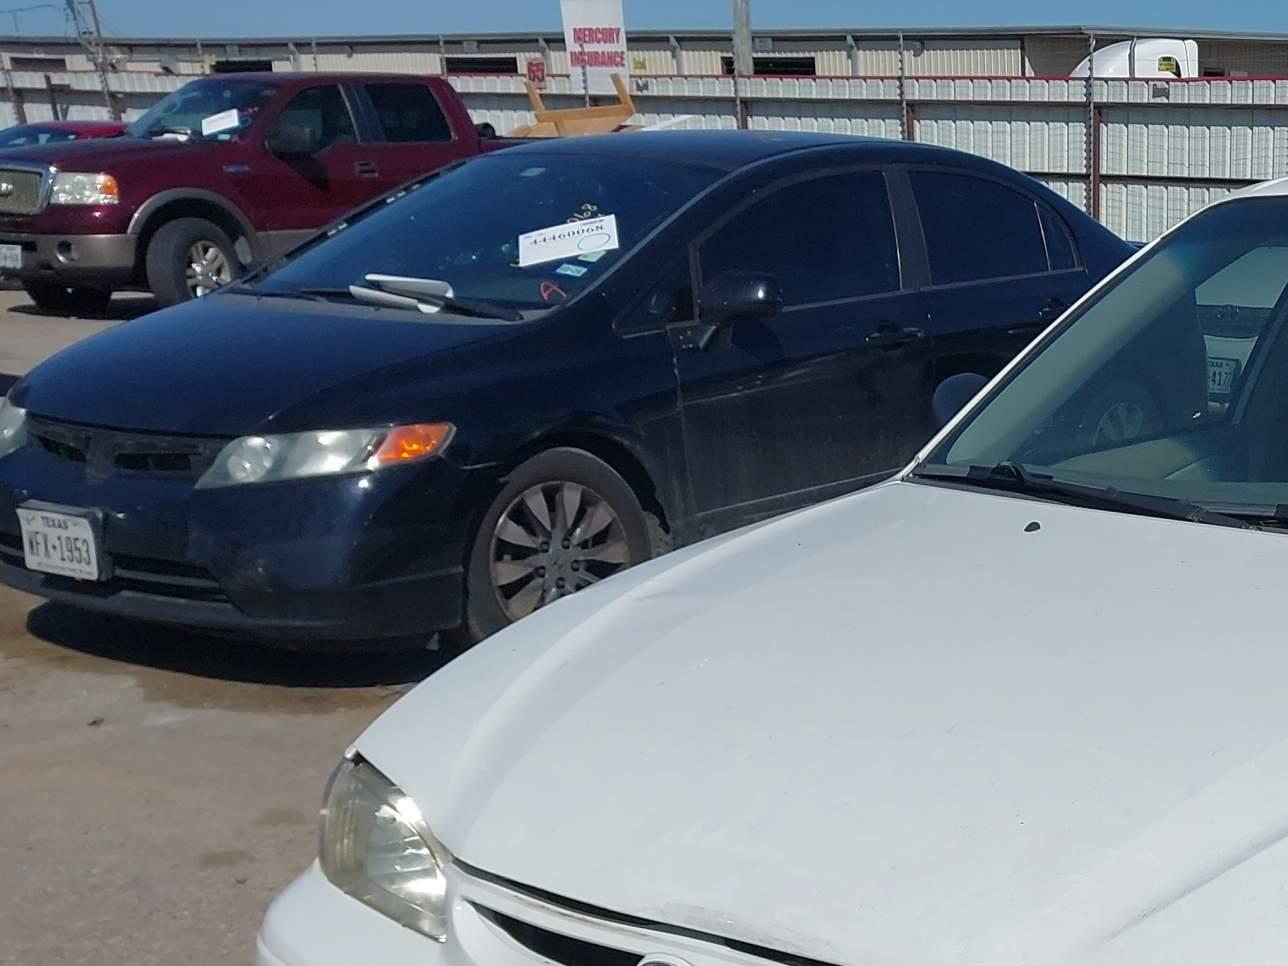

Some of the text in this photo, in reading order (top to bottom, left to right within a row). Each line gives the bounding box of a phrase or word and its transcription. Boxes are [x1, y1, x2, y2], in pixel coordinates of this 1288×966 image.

[573, 27, 621, 44] MERCURY
[570, 51, 625, 67] INSURANCE
[40, 516, 68, 530] TEXAS
